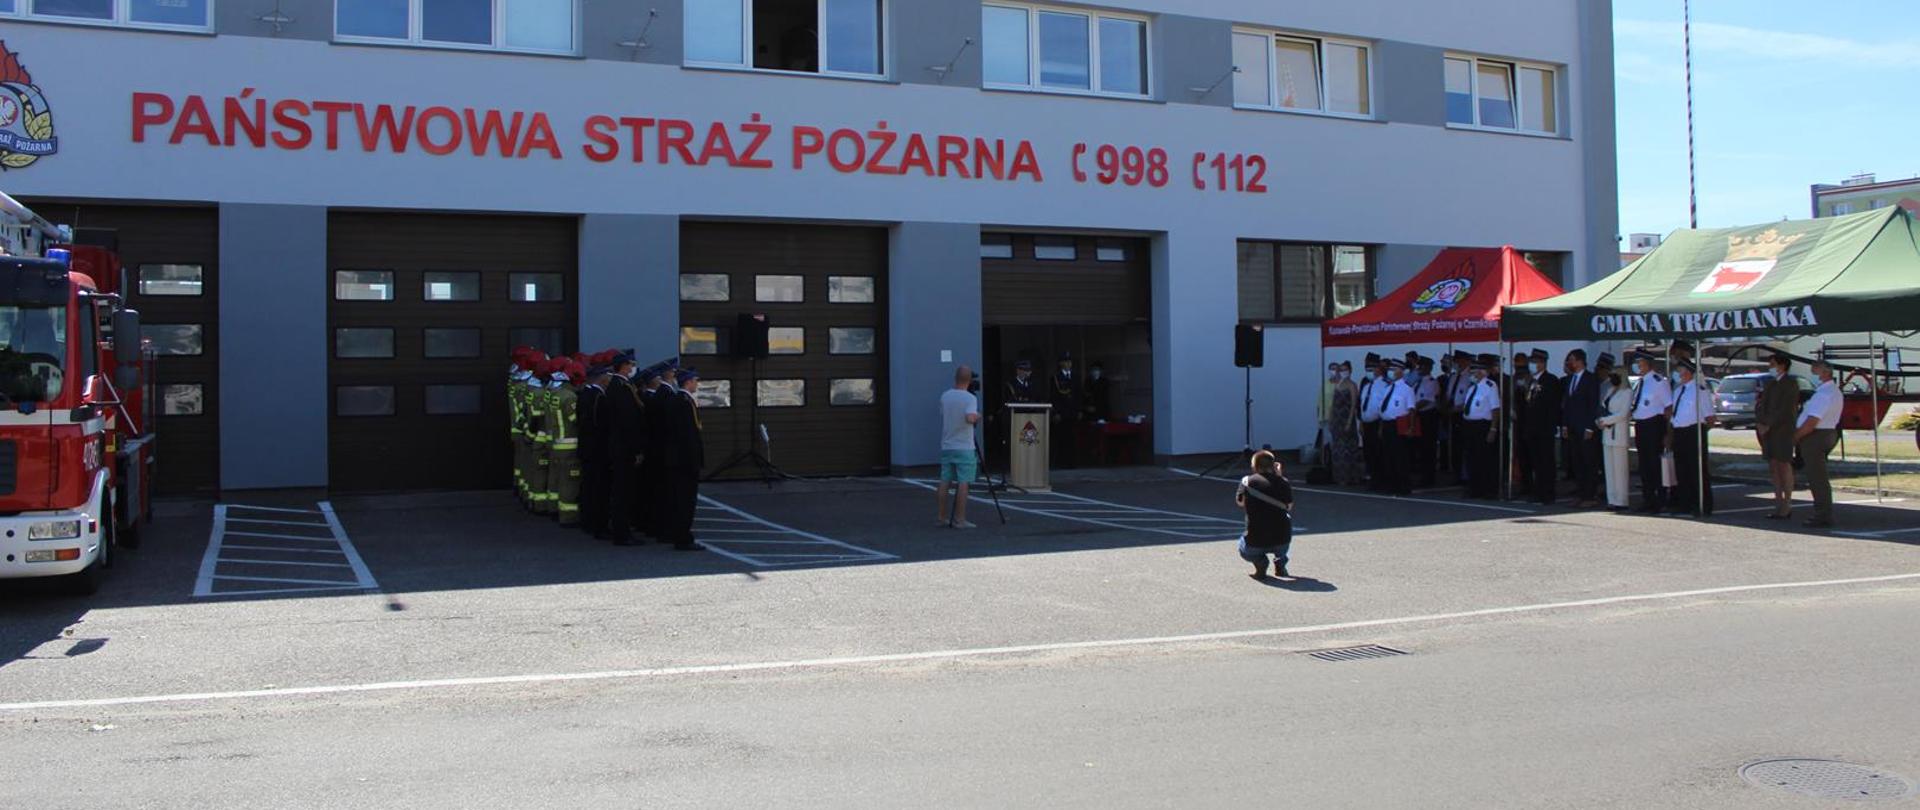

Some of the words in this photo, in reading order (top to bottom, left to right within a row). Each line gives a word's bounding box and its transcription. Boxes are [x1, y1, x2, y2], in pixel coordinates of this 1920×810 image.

[16, 140, 53, 151] POŻARNA
[131, 88, 562, 160] PAŃSTWOWA
[583, 113, 773, 169] STRAŻ
[792, 121, 1042, 182] POŻARNA
[1096, 143, 1169, 188] 998
[1209, 153, 1268, 194] 112
[1591, 313, 1665, 334] GMINA
[1668, 304, 1818, 333] TRZCIANKA
